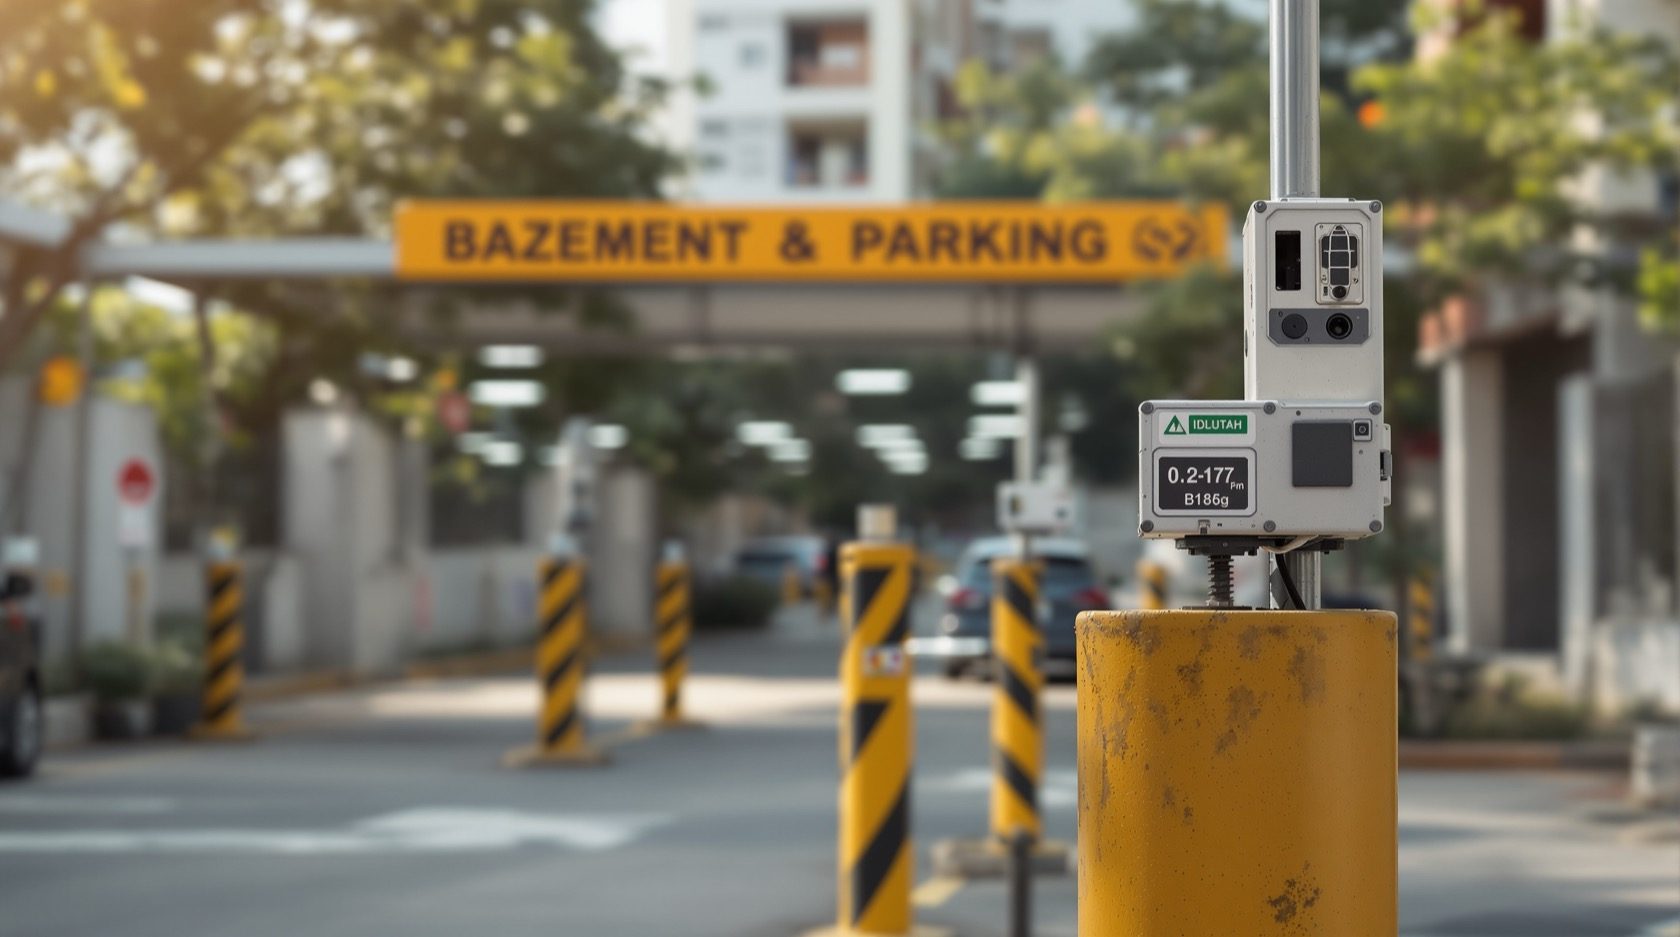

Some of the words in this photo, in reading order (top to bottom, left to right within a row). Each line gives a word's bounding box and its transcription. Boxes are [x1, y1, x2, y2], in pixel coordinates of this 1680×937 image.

[444, 219, 748, 263] BAZEMENT
[778, 219, 817, 263] &
[851, 219, 1108, 263] PARKING
[1193, 418, 1242, 430] IDLUTAH
[1167, 466, 1235, 484] 0.2-177
